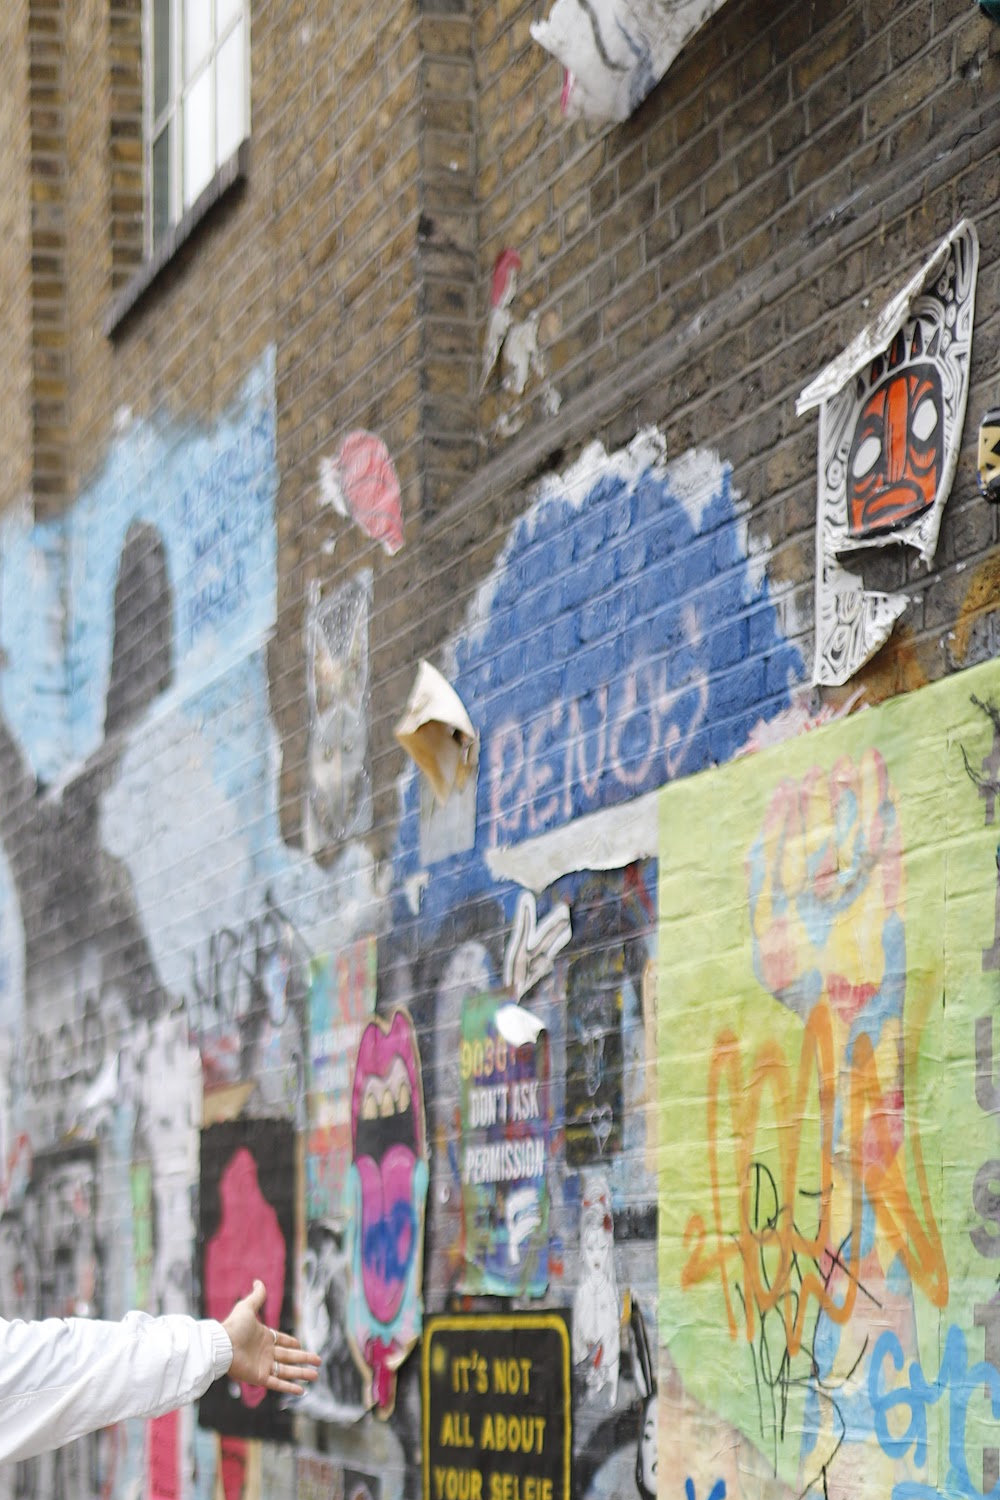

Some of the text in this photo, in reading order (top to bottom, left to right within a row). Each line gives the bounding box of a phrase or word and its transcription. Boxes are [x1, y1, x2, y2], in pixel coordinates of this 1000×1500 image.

[469, 1081, 540, 1128] DON'T ASK
[464, 1140, 545, 1184] PERMISSION
[453, 1350, 531, 1395] IT'S NOT
[440, 1412, 546, 1454] ALL ABOUT
